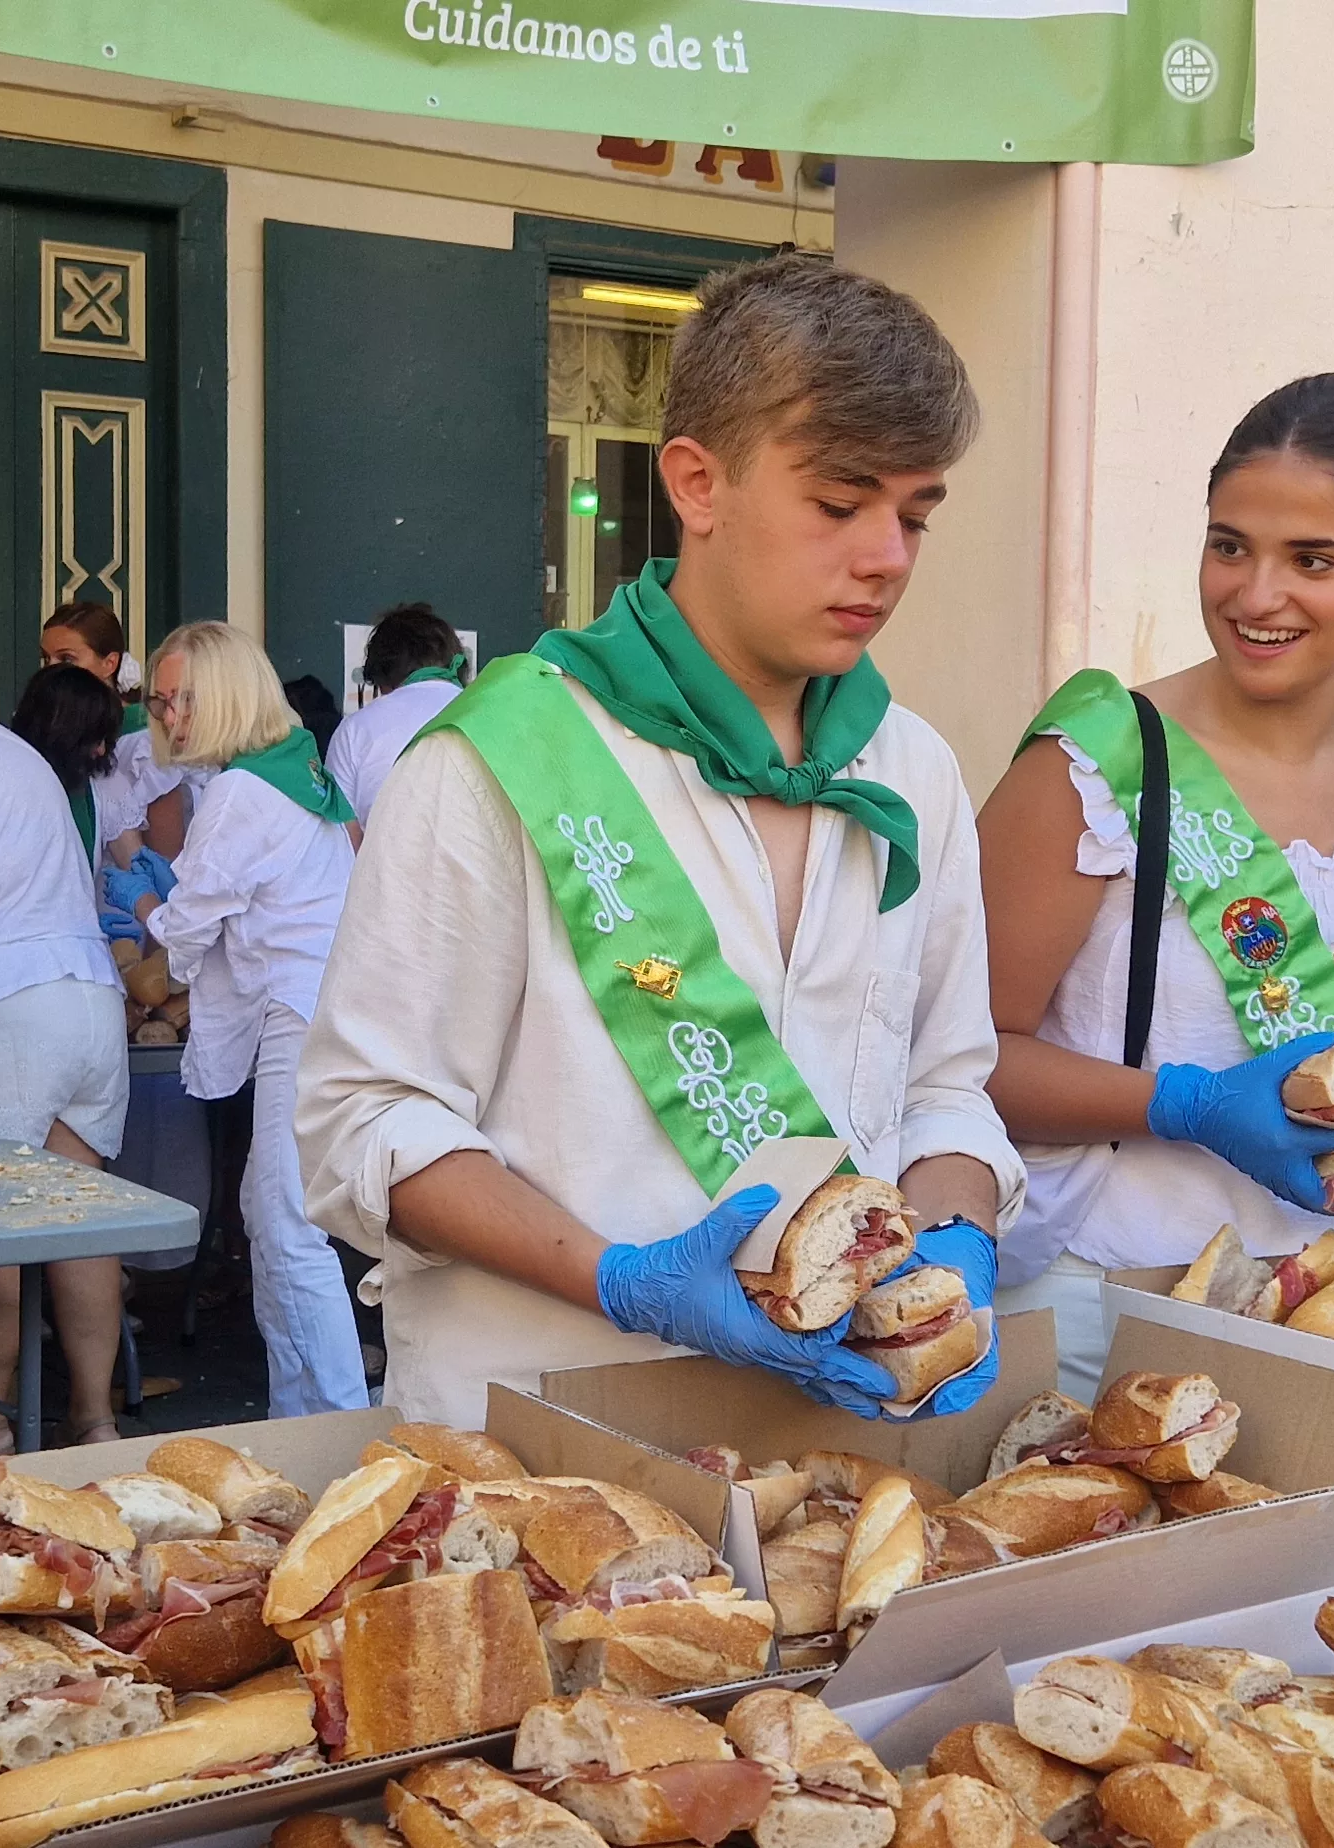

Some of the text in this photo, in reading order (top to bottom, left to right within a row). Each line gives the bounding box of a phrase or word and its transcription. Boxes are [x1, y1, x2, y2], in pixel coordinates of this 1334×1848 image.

[405, 0, 750, 73] Cuidamos de ti
